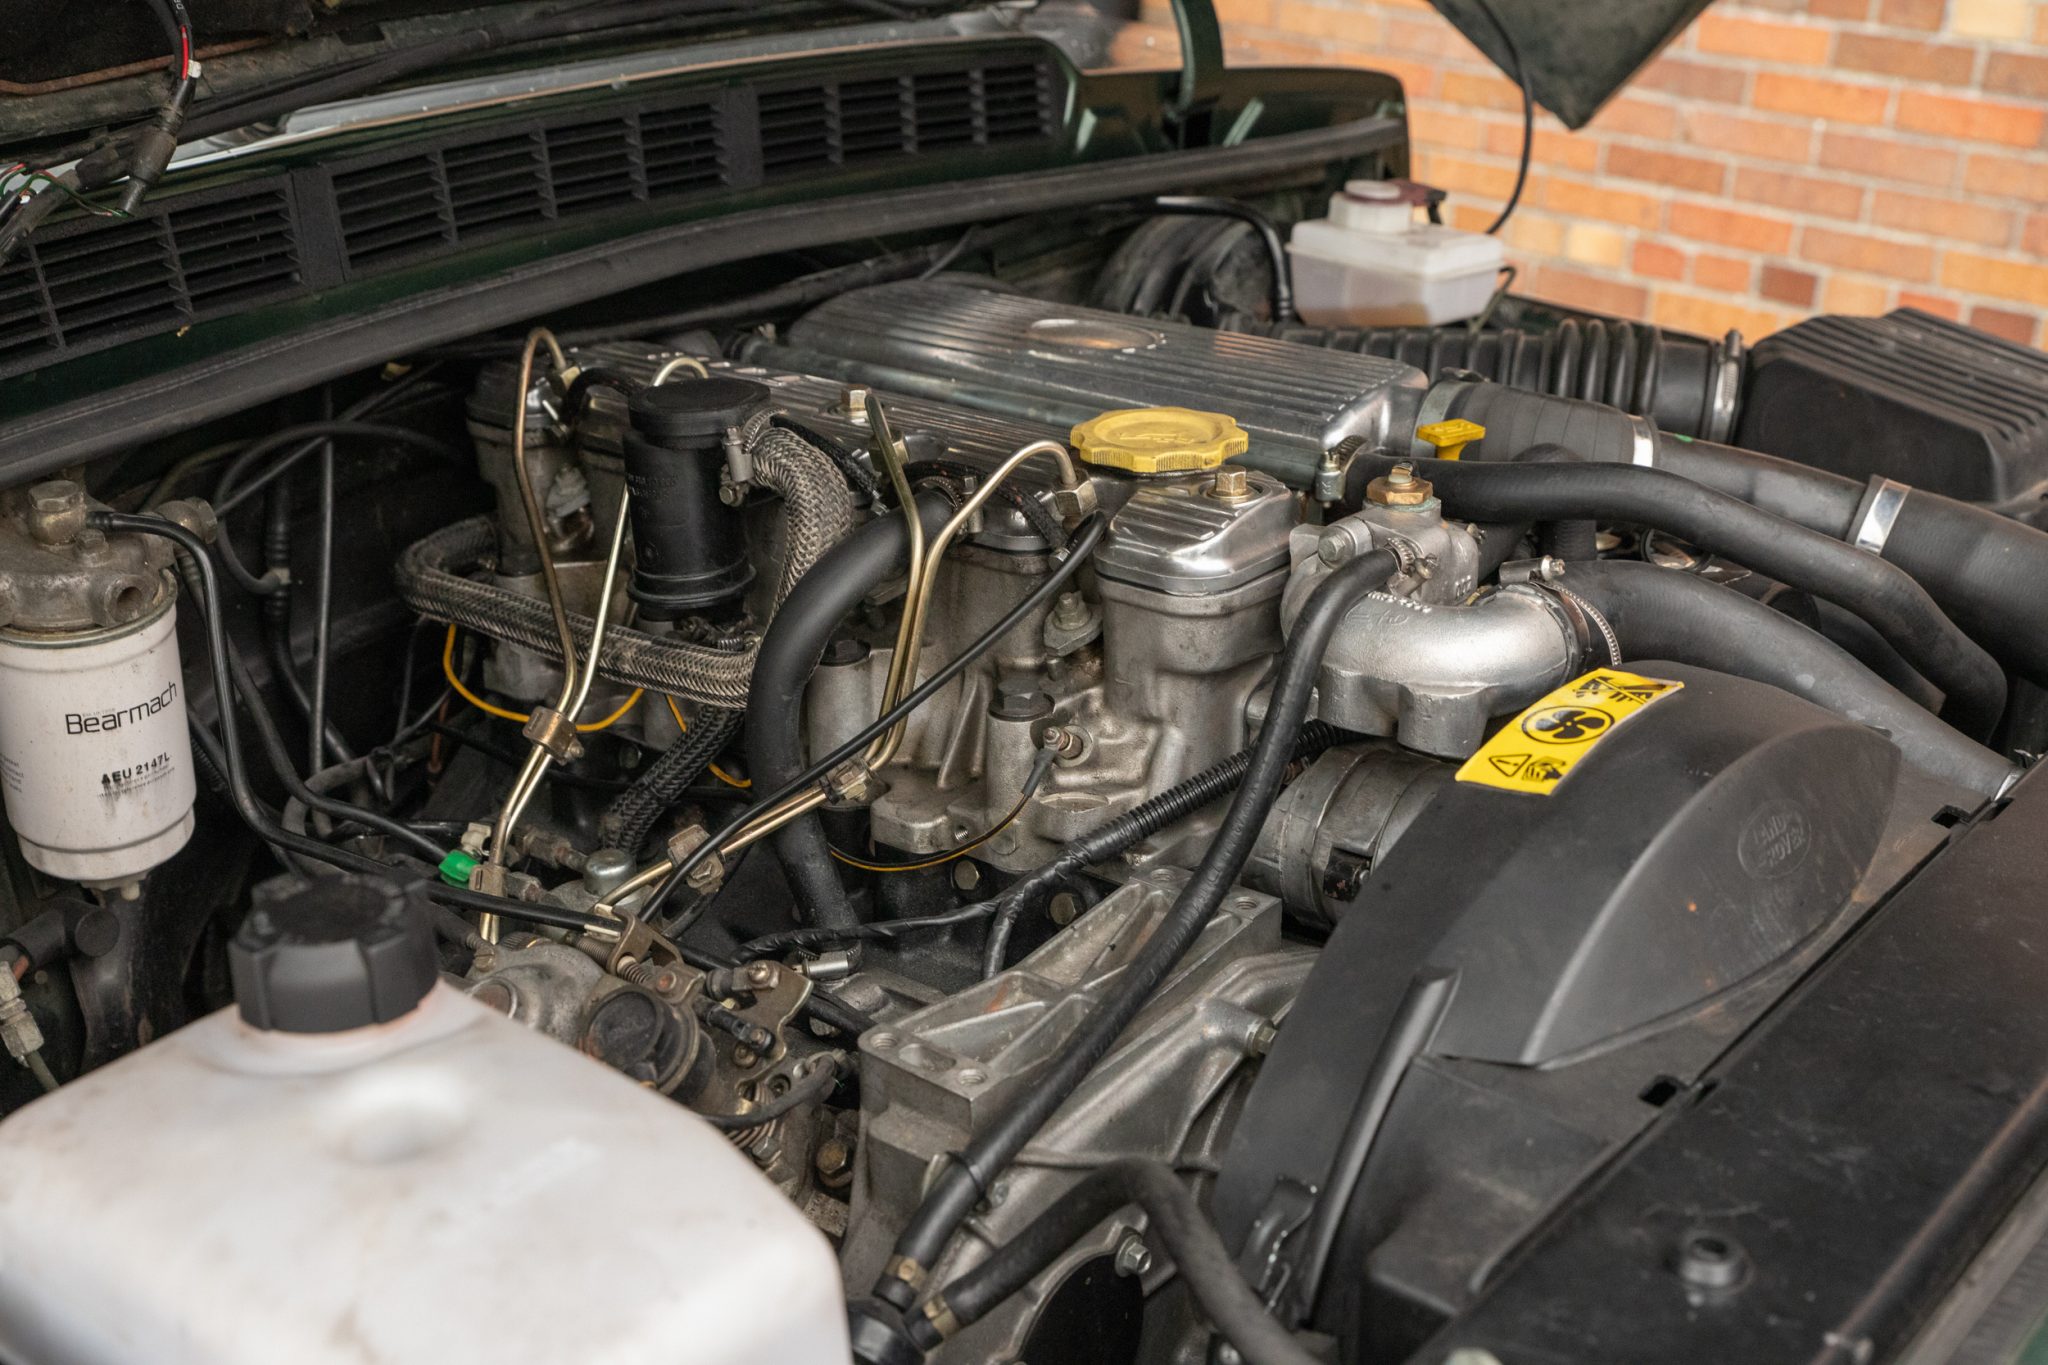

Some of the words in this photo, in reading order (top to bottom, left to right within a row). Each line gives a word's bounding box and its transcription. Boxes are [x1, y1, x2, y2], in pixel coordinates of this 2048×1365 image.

[65, 681, 178, 735] Bearmach
[101, 767, 132, 785] AEU
[135, 752, 170, 775] 2147L
